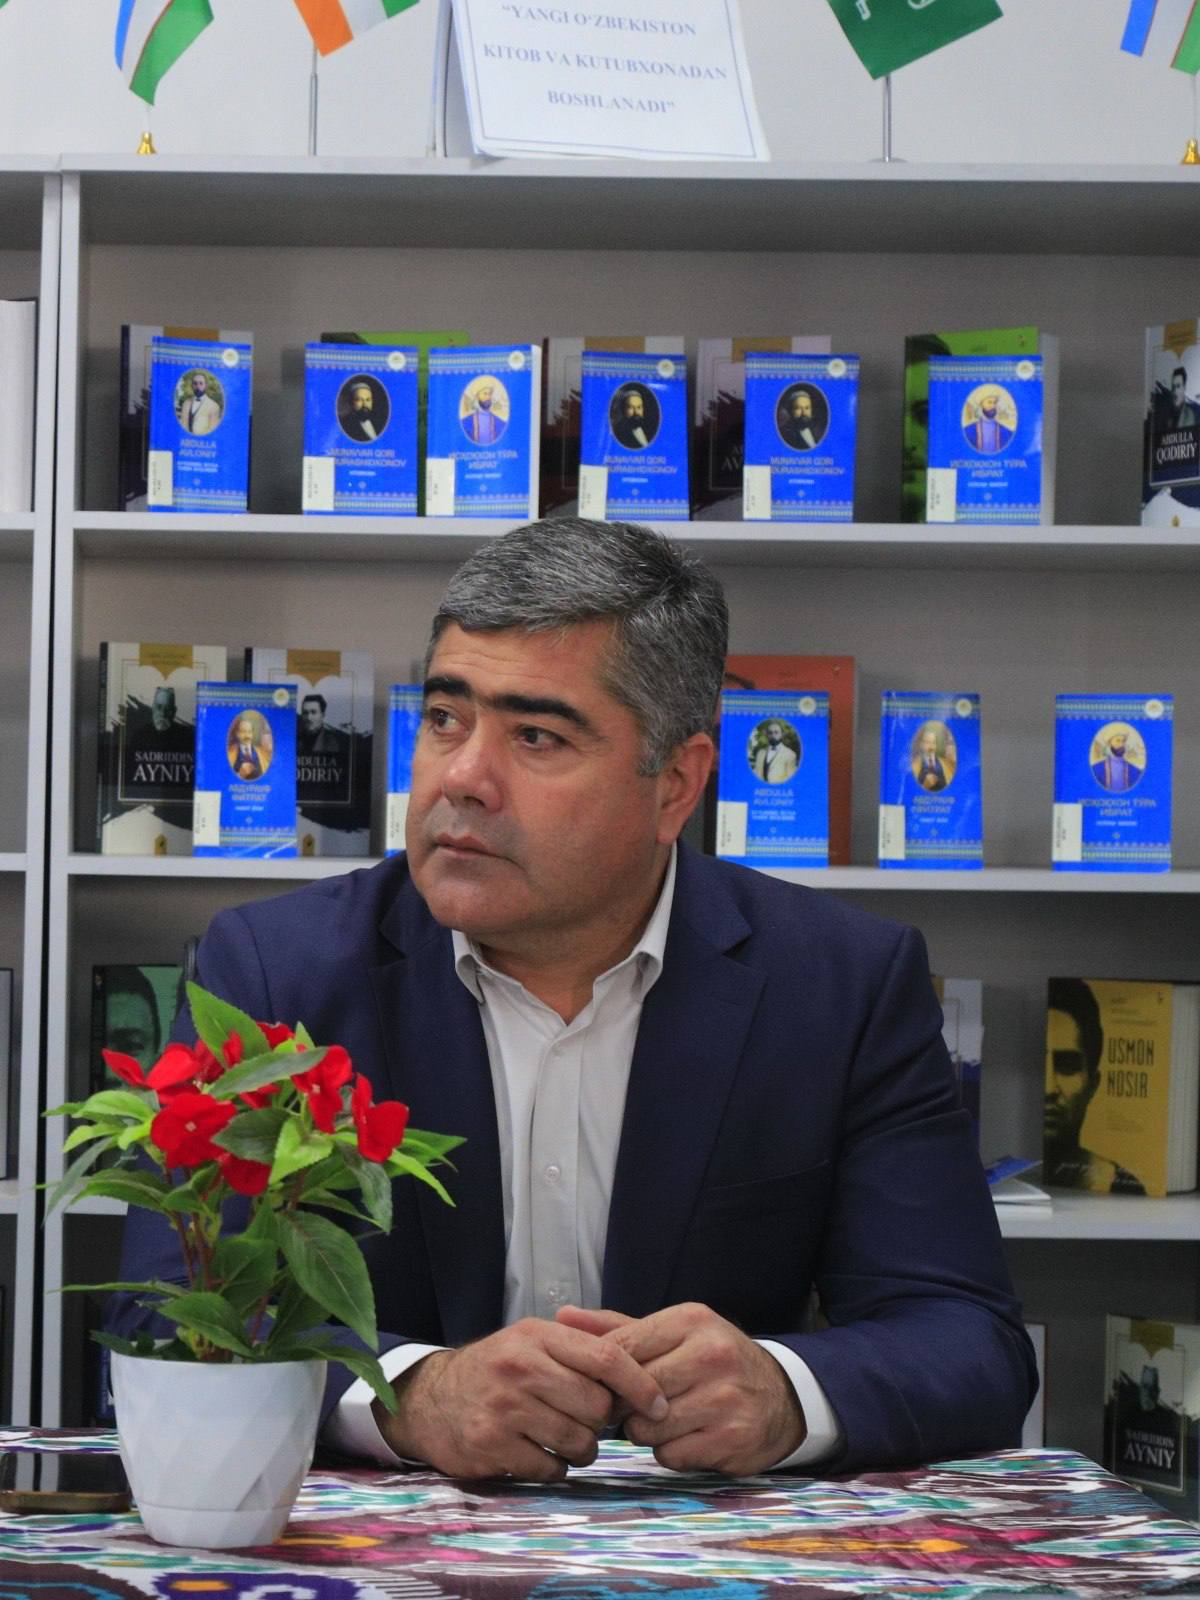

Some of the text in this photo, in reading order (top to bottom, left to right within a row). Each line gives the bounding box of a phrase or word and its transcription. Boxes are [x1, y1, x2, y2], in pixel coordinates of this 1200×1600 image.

[483, 43, 728, 79] KITOB VA KUTUBXONADAN
[1156, 442, 1197, 464] QODIRIY
[132, 763, 193, 782] AYNIY
[1107, 1037, 1154, 1066] USMON
[1106, 1069, 1148, 1098] NOSIR
[1123, 1442, 1176, 1469] AYNIY
